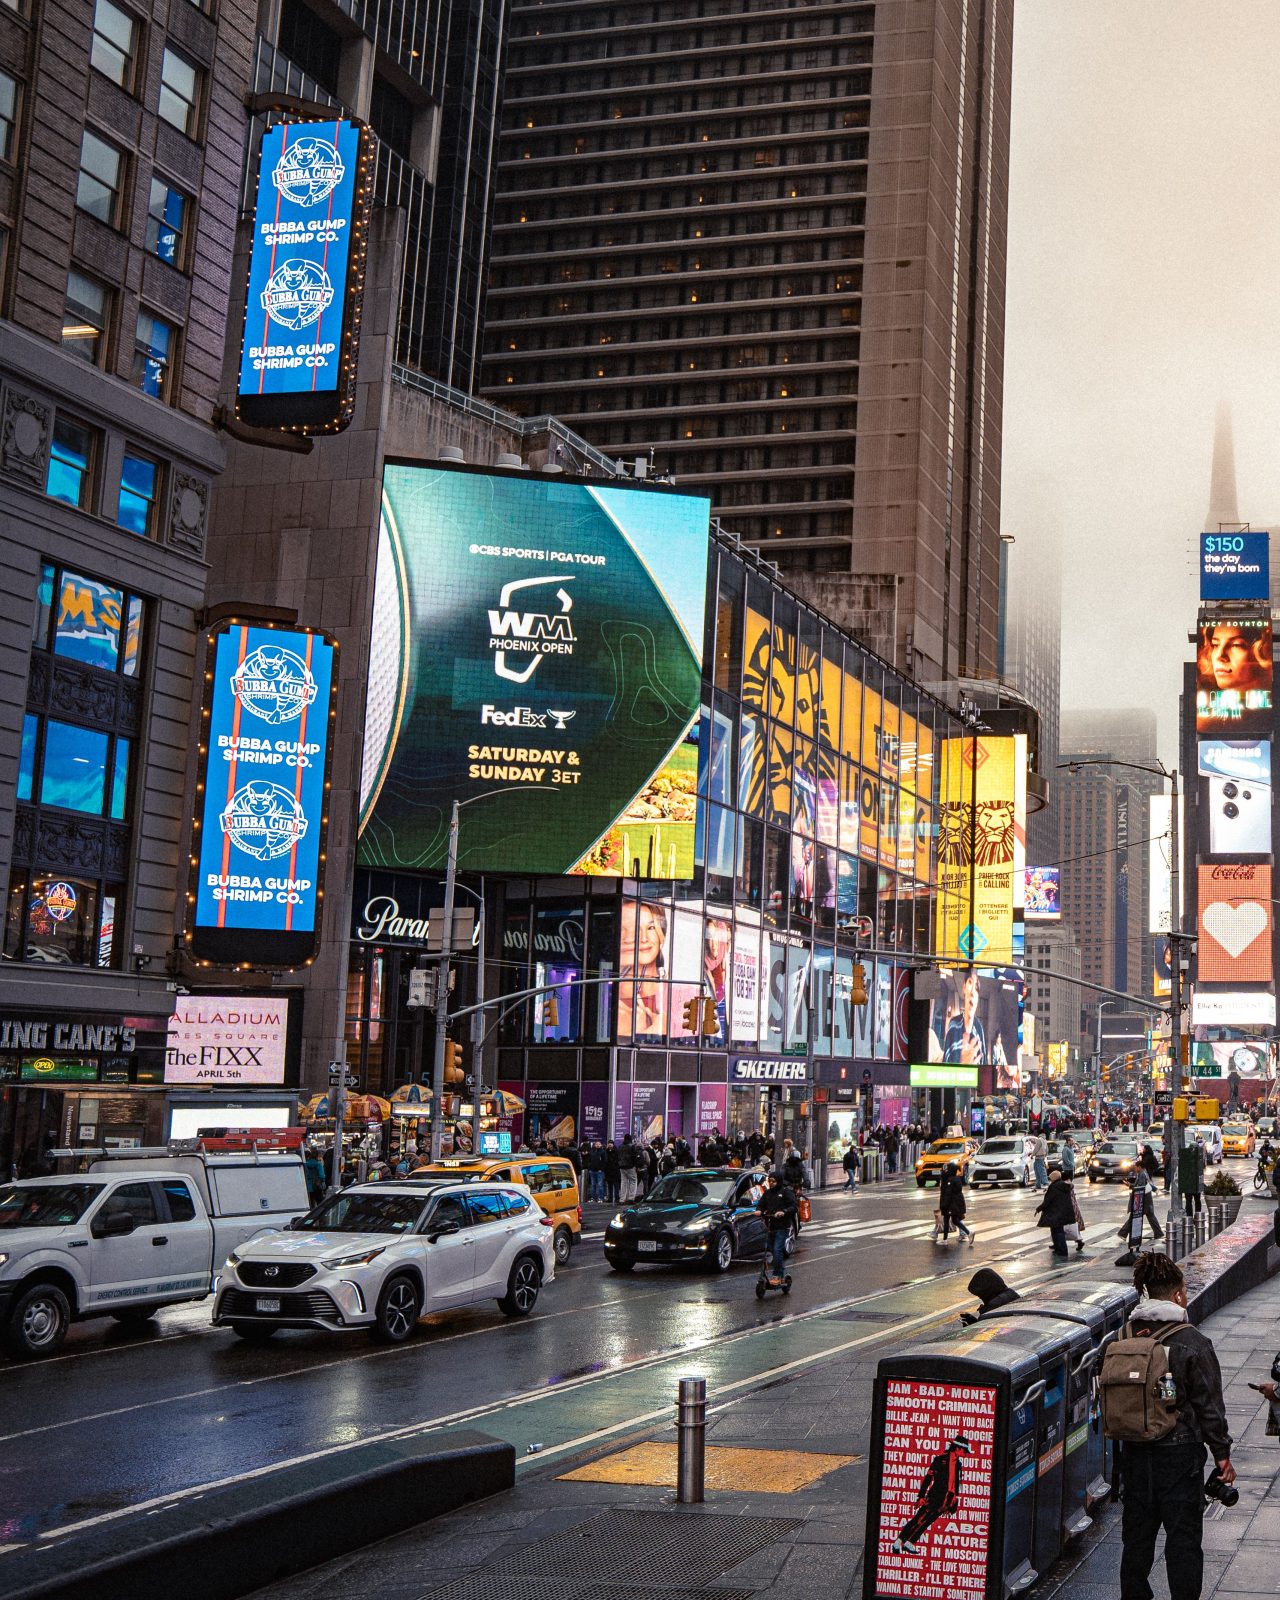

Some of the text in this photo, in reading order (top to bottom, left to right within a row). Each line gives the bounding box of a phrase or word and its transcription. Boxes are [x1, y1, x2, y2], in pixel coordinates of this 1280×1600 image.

[261, 219, 346, 234] BUBBA GUMP
[265, 231, 339, 245] SHRIMP CO.
[249, 343, 335, 357] BUBBA GUMP
[253, 356, 328, 370] SHRIMP CO.
[1205, 536, 1244, 553] $150
[479, 545, 606, 566] CBS SPORTS PGA TOUR
[1204, 554, 1240, 564] the day
[1204, 564, 1236, 574] they're
[489, 638, 573, 655] PHOENIX OPEN
[236, 680, 314, 698] BUBBA GUMP
[481, 704, 547, 728] FedEx
[218, 735, 320, 755] BUBBA GUMP
[223, 749, 313, 768] SHRIMP CO.
[467, 744, 580, 766] SATURDAY &
[468, 764, 545, 781] SUNDAY
[225, 816, 304, 833] BUBBA GUMP
[207, 874, 311, 891] BUBBA GUMP
[212, 888, 304, 904] SHRIMP CO.
[54, 1023, 136, 1051] CANE'S
[36, 1060, 52, 1070] OPEN
[167, 1046, 264, 1067] the FIXX
[197, 1070, 242, 1078] APRIL 5th
[737, 1060, 806, 1079] SKECHERS
[1192, 1067, 1213, 1075] W 44
[584, 1106, 603, 1117] 1515
[65, 1105, 74, 1146] Newsstand
[887, 1383, 995, 1401] JAM BAD MONEY
[887, 1396, 994, 1415] SMOOTH CRIMINAL
[886, 1410, 908, 1421] BILLIE
[910, 1412, 929, 1423] JEAN
[943, 1414, 961, 1426] WANT
[962, 1416, 975, 1428] YOU
[977, 1418, 994, 1429] BACK
[885, 1423, 993, 1442] BLAME IT ON THE BOOGIE
[884, 1436, 992, 1455] CAN YOU IT
[883, 1450, 992, 1469] THEY DON'T US
[882, 1477, 921, 1490] MAN IN
[881, 1490, 901, 1500] DON'T
[963, 1497, 990, 1509] ENOUGH
[881, 1503, 989, 1523] KEEP THE OR WHITE
[945, 1522, 988, 1536] ABC
[934, 1534, 988, 1549] NATURE
[931, 1547, 988, 1562] IN MOSCOW
[878, 1555, 987, 1576] TABLOID JUNKIE THE LOVE YOU SAVE
[877, 1568, 986, 1588] THRILLER I'LL BE THERE
[876, 1582, 901, 1594] WANNA
[903, 1584, 912, 1595] BE
